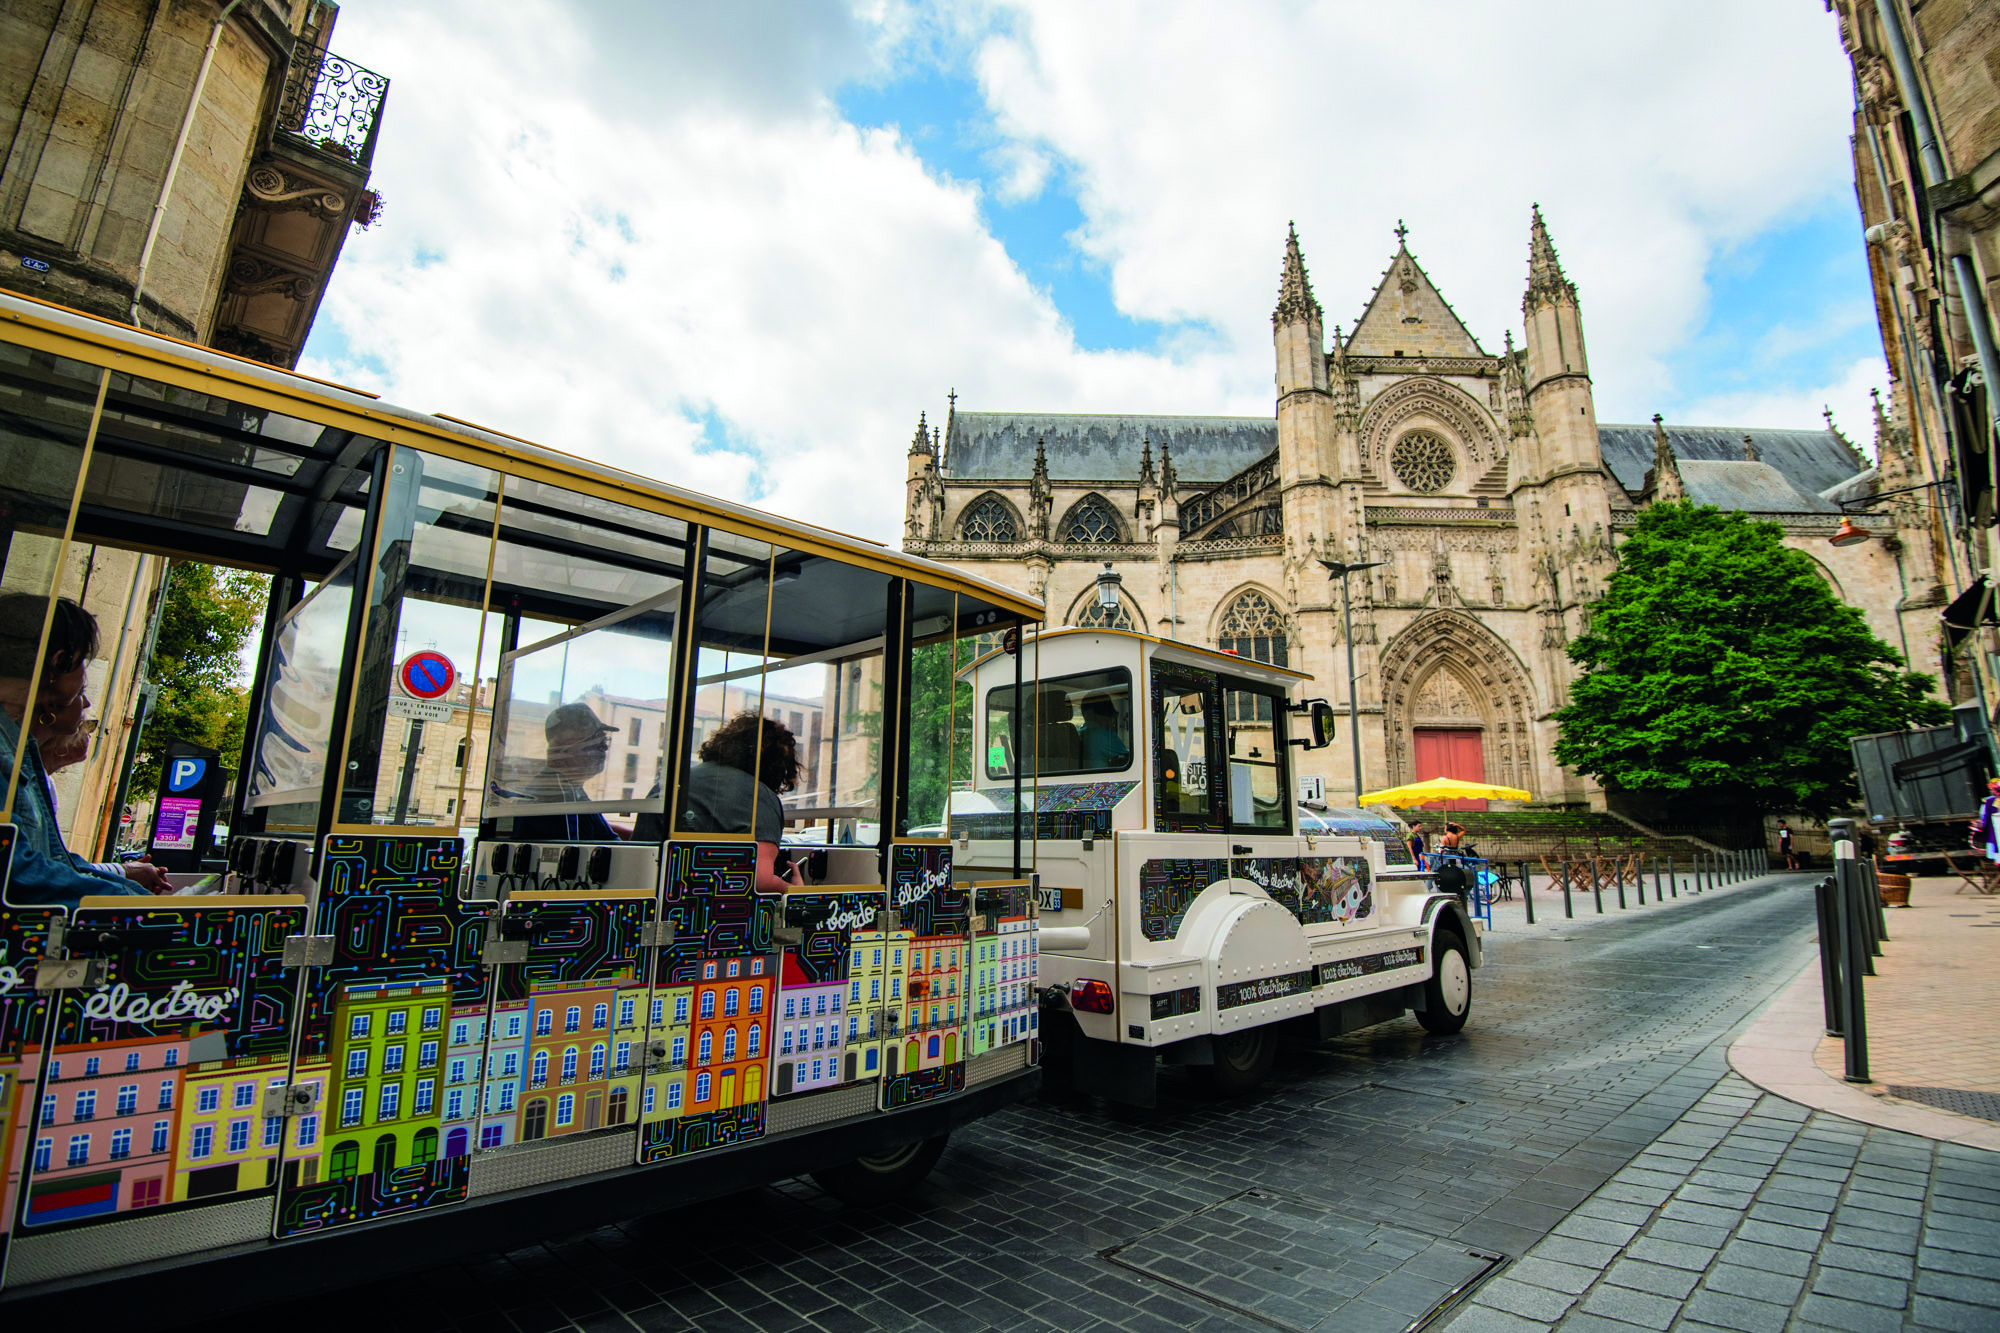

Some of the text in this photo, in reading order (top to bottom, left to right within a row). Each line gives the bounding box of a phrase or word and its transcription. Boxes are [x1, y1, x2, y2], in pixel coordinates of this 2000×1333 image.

[411, 703, 448, 712] L'ENSEMBLE
[174, 760, 197, 786] P
[1383, 953, 1396, 967] 100%
[1323, 968, 1337, 980] 100%
[1240, 979, 1292, 1001] 100% électrique
